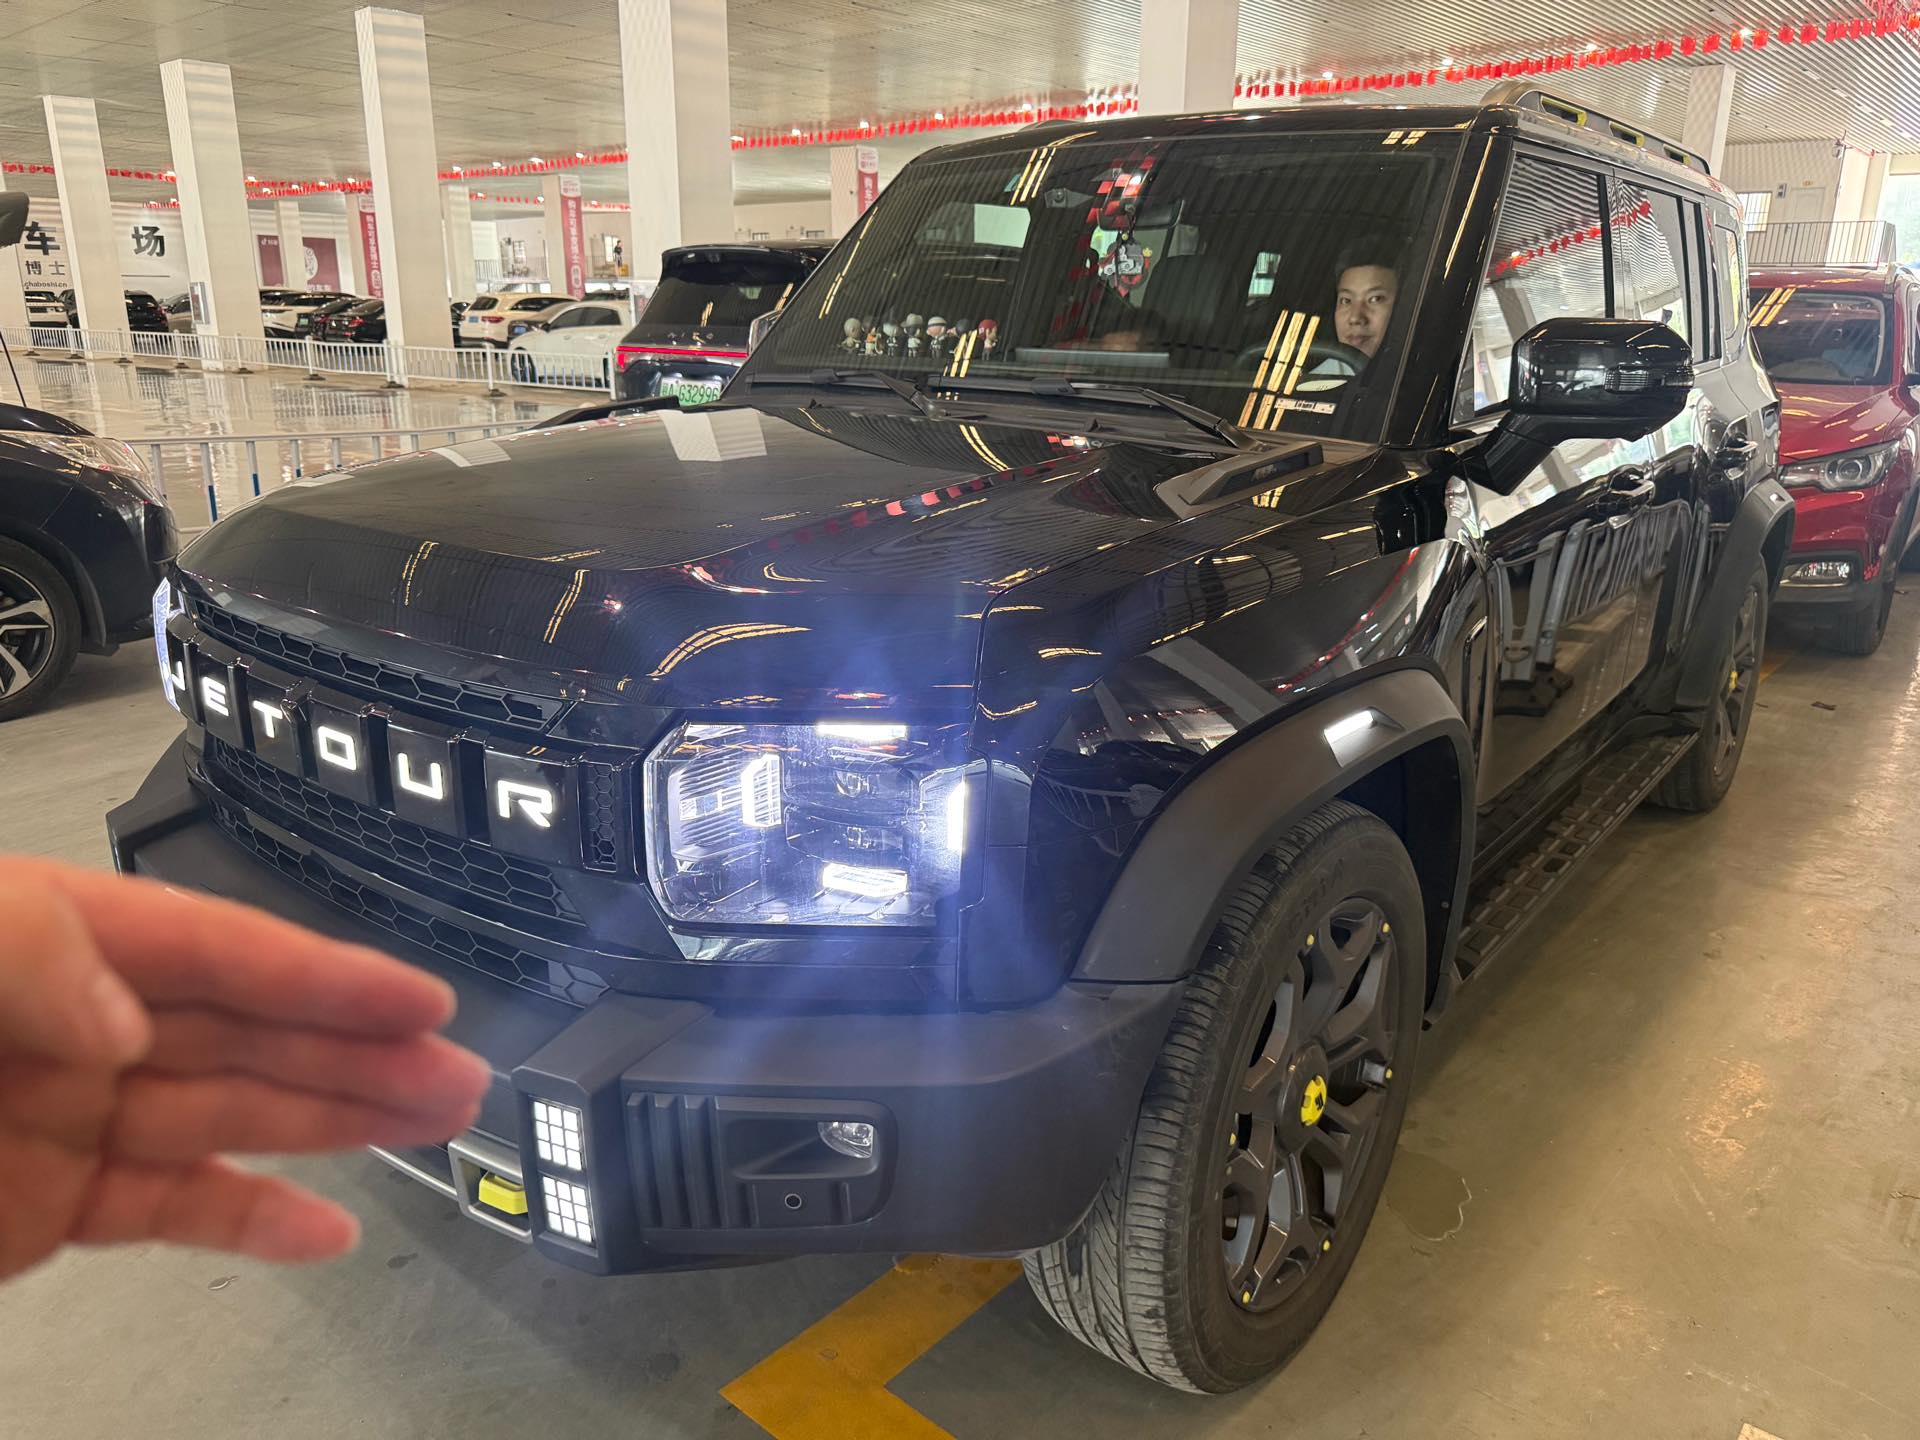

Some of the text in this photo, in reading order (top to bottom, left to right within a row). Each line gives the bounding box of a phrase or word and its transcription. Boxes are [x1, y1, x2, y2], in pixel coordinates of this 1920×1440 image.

[24, 221, 165, 257] 车 场
[25, 260, 65, 275] 博士
[171, 660, 554, 828] JETOUR
